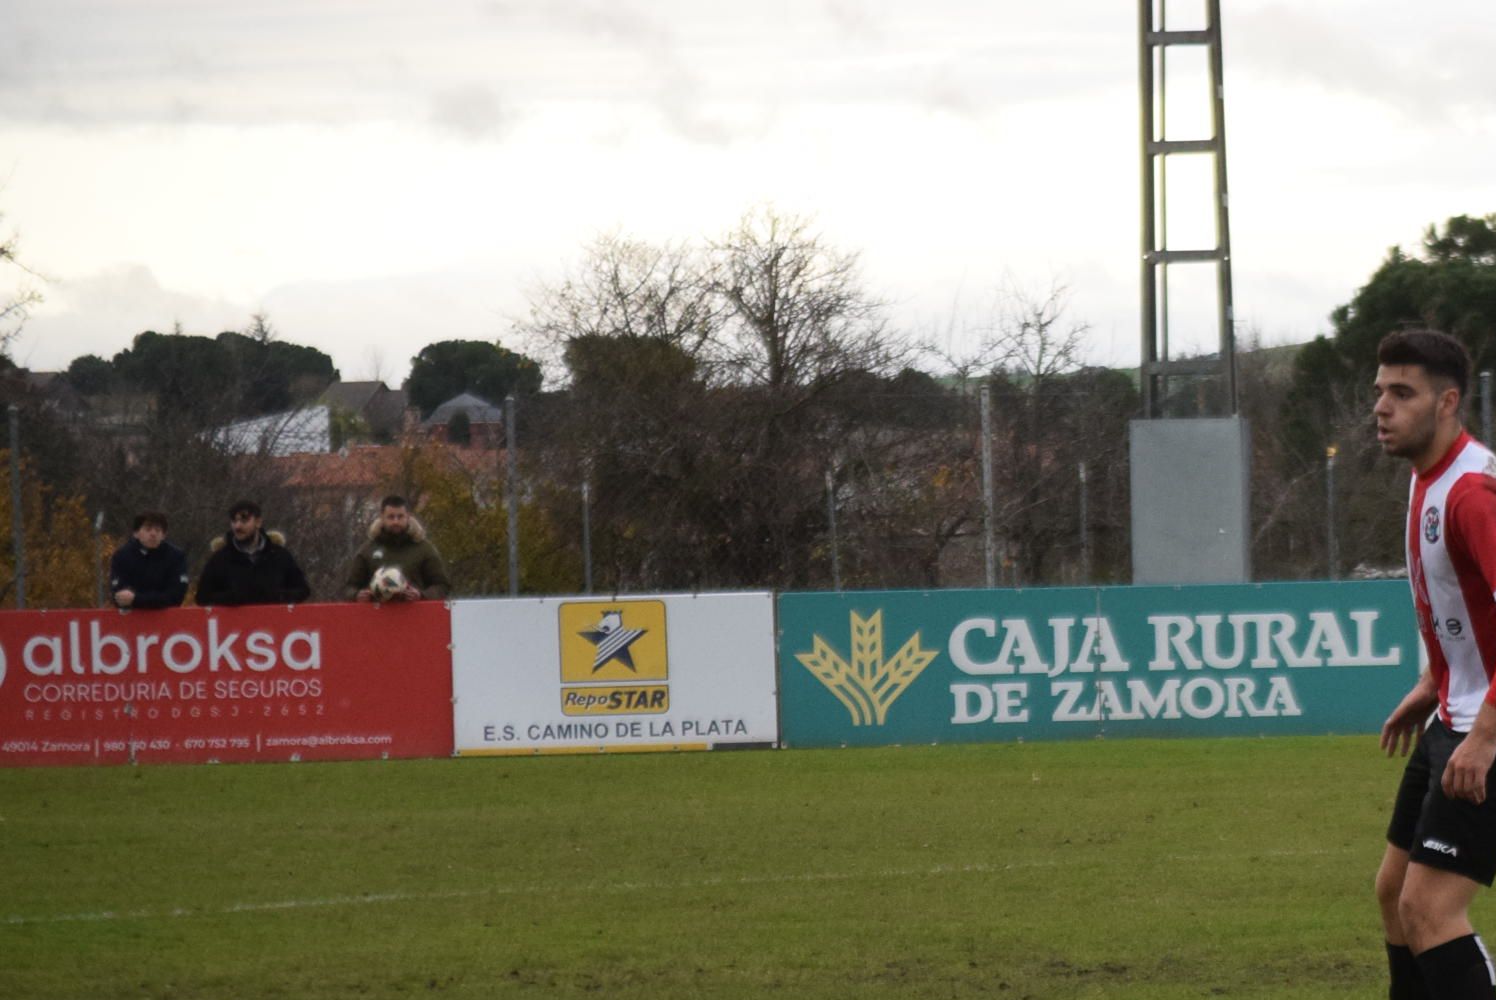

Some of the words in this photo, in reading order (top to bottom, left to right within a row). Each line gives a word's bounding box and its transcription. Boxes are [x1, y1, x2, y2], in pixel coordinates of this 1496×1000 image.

[23, 617, 322, 675] albroksa
[947, 616, 1130, 677] CAJA
[1147, 611, 1400, 671] RURAL
[24, 682, 171, 702] CORREDURIA
[180, 681, 206, 700] DE
[214, 679, 322, 698] SEGUROS
[565, 690, 666, 710] RepoSTAR
[950, 683, 1029, 724] DE
[1051, 676, 1302, 722] ZAMORA
[484, 725, 520, 741] E.S.
[528, 723, 608, 740] CAMINO
[616, 722, 642, 738] DE
[650, 721, 675, 737] LA
[682, 719, 748, 736] PLATA
